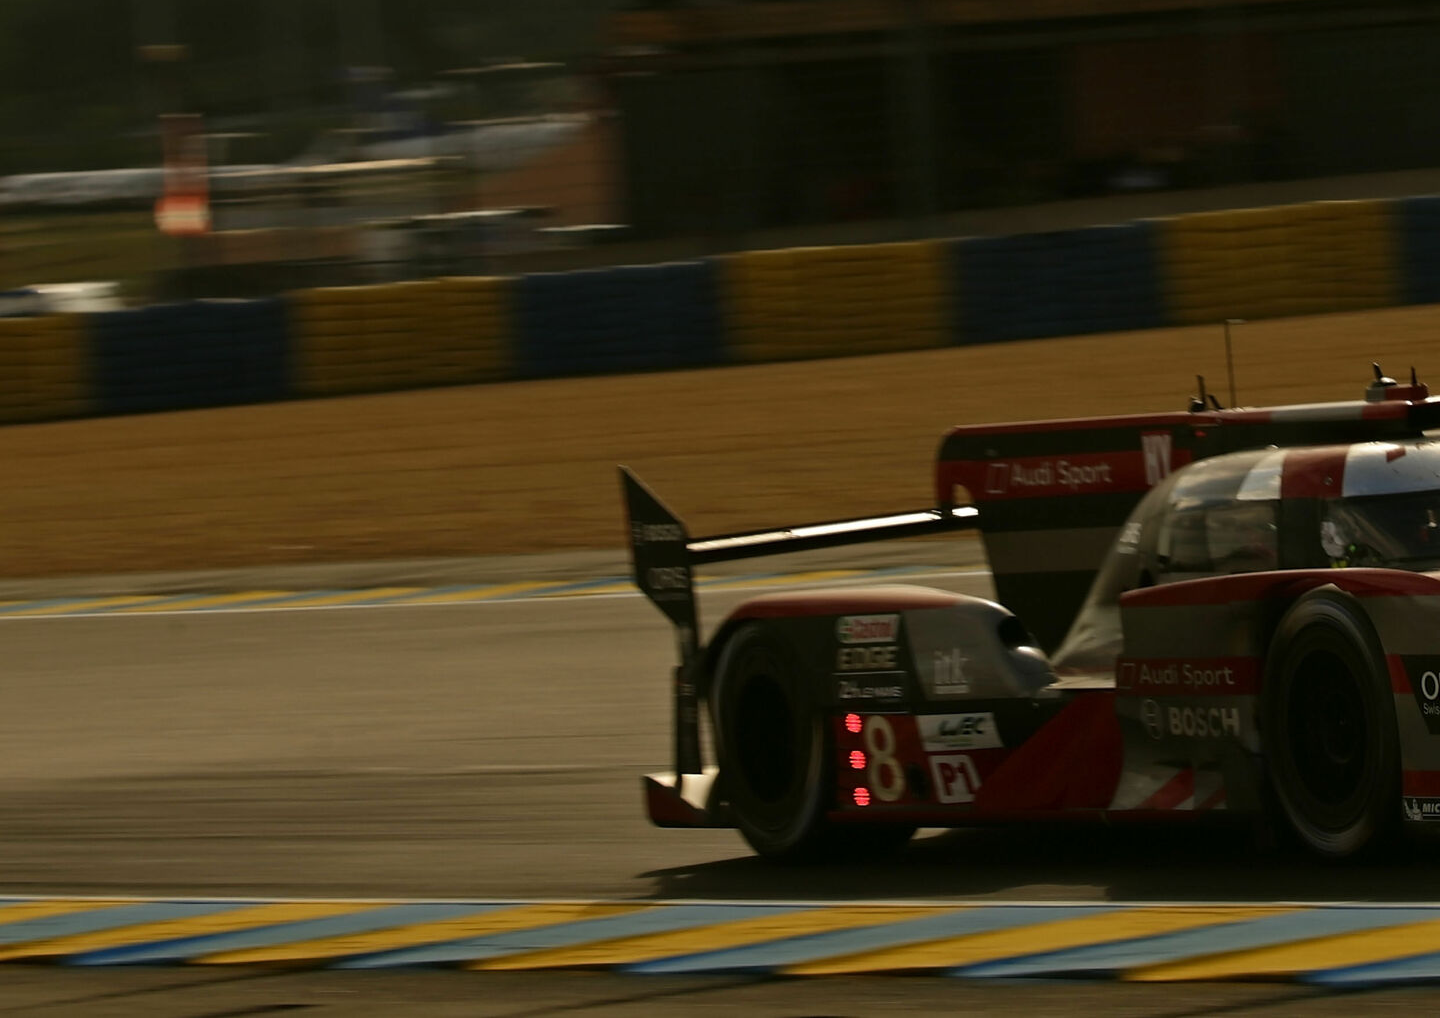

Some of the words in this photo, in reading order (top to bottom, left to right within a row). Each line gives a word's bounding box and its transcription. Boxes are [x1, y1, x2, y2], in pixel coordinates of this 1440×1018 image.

[1010, 462, 1056, 487] Audi
[1056, 460, 1112, 491] Sport
[838, 646, 898, 670] EDGE
[1139, 663, 1178, 685] Audi
[1182, 663, 1236, 689] Sport
[1168, 707, 1240, 738] BOSCH
[864, 715, 907, 802] 8
[938, 761, 976, 796] P1
